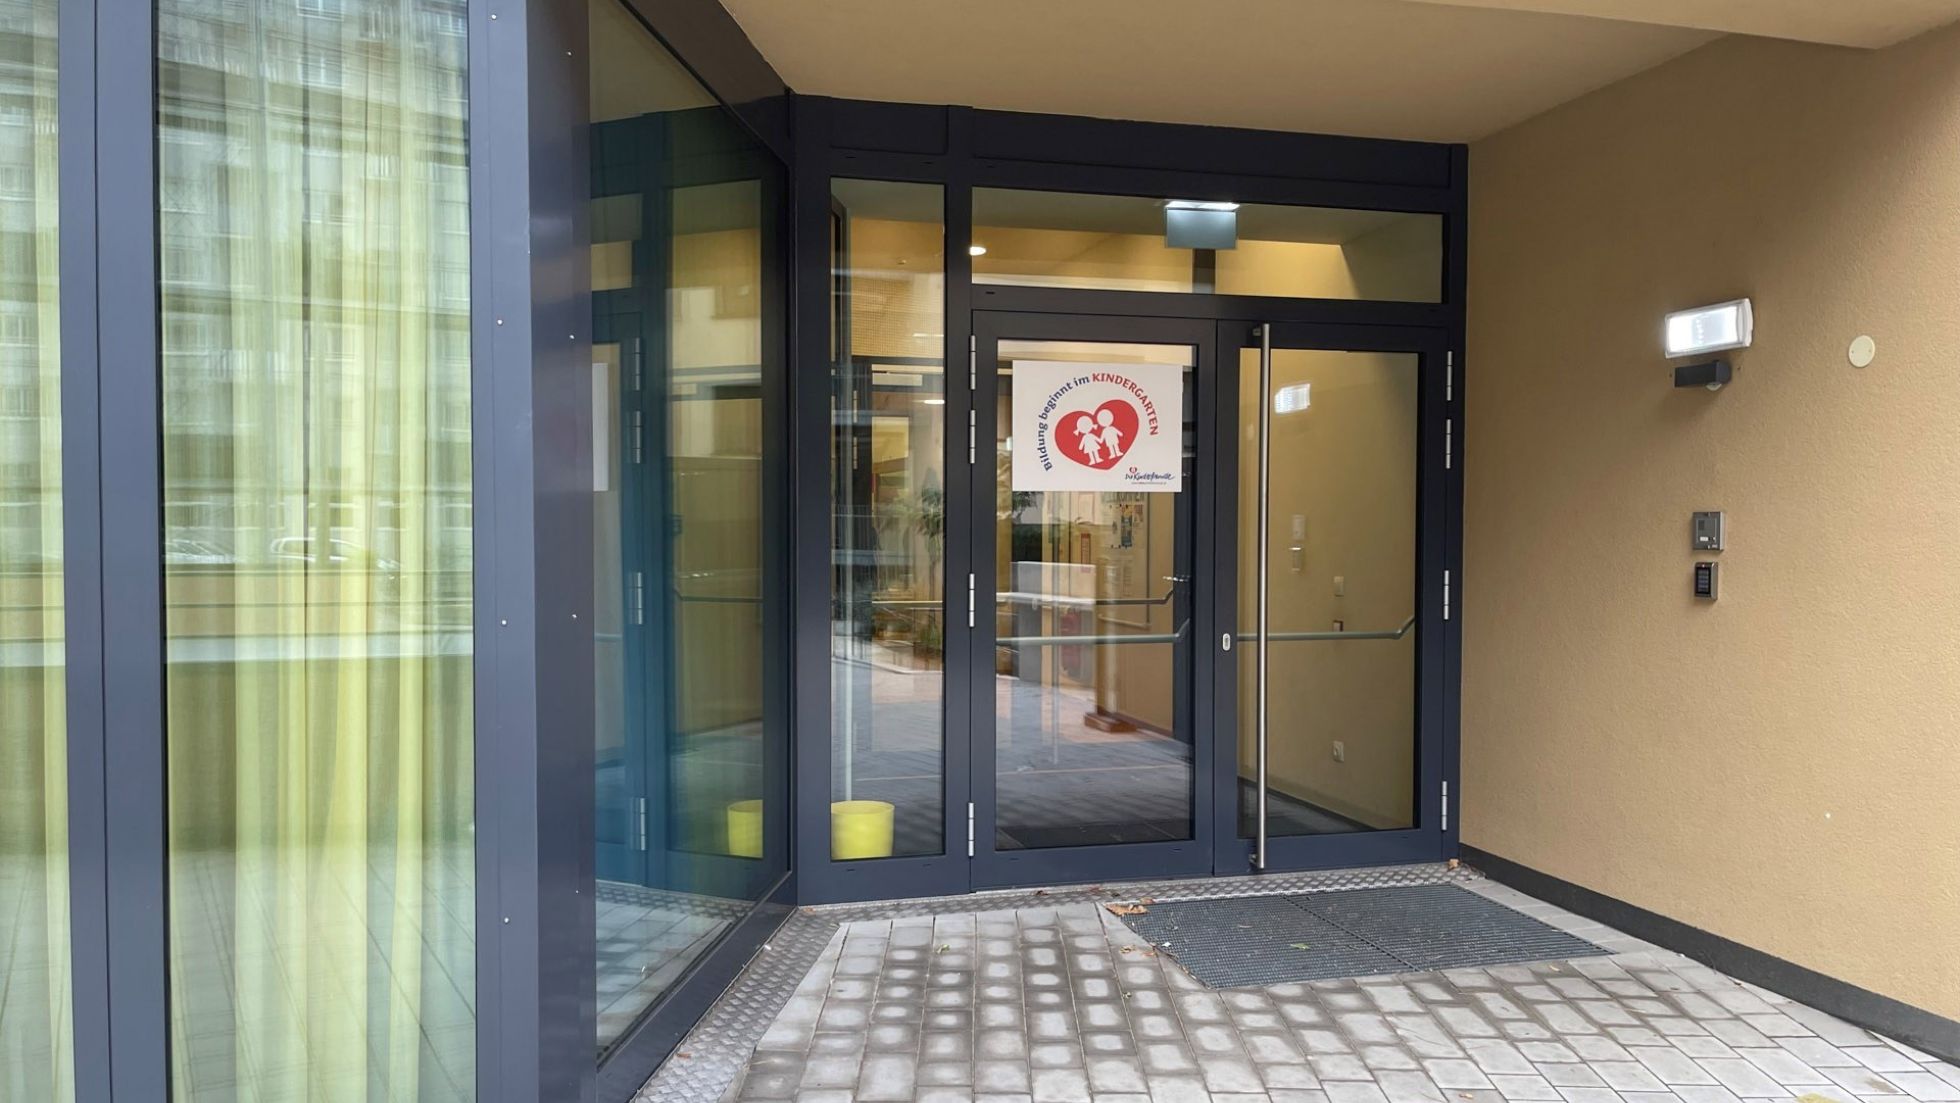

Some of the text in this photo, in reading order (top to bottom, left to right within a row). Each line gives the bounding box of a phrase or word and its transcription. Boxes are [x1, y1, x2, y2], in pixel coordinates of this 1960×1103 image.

[1037, 373, 1159, 471] Bildung beginnt im KINDERGARTEN
